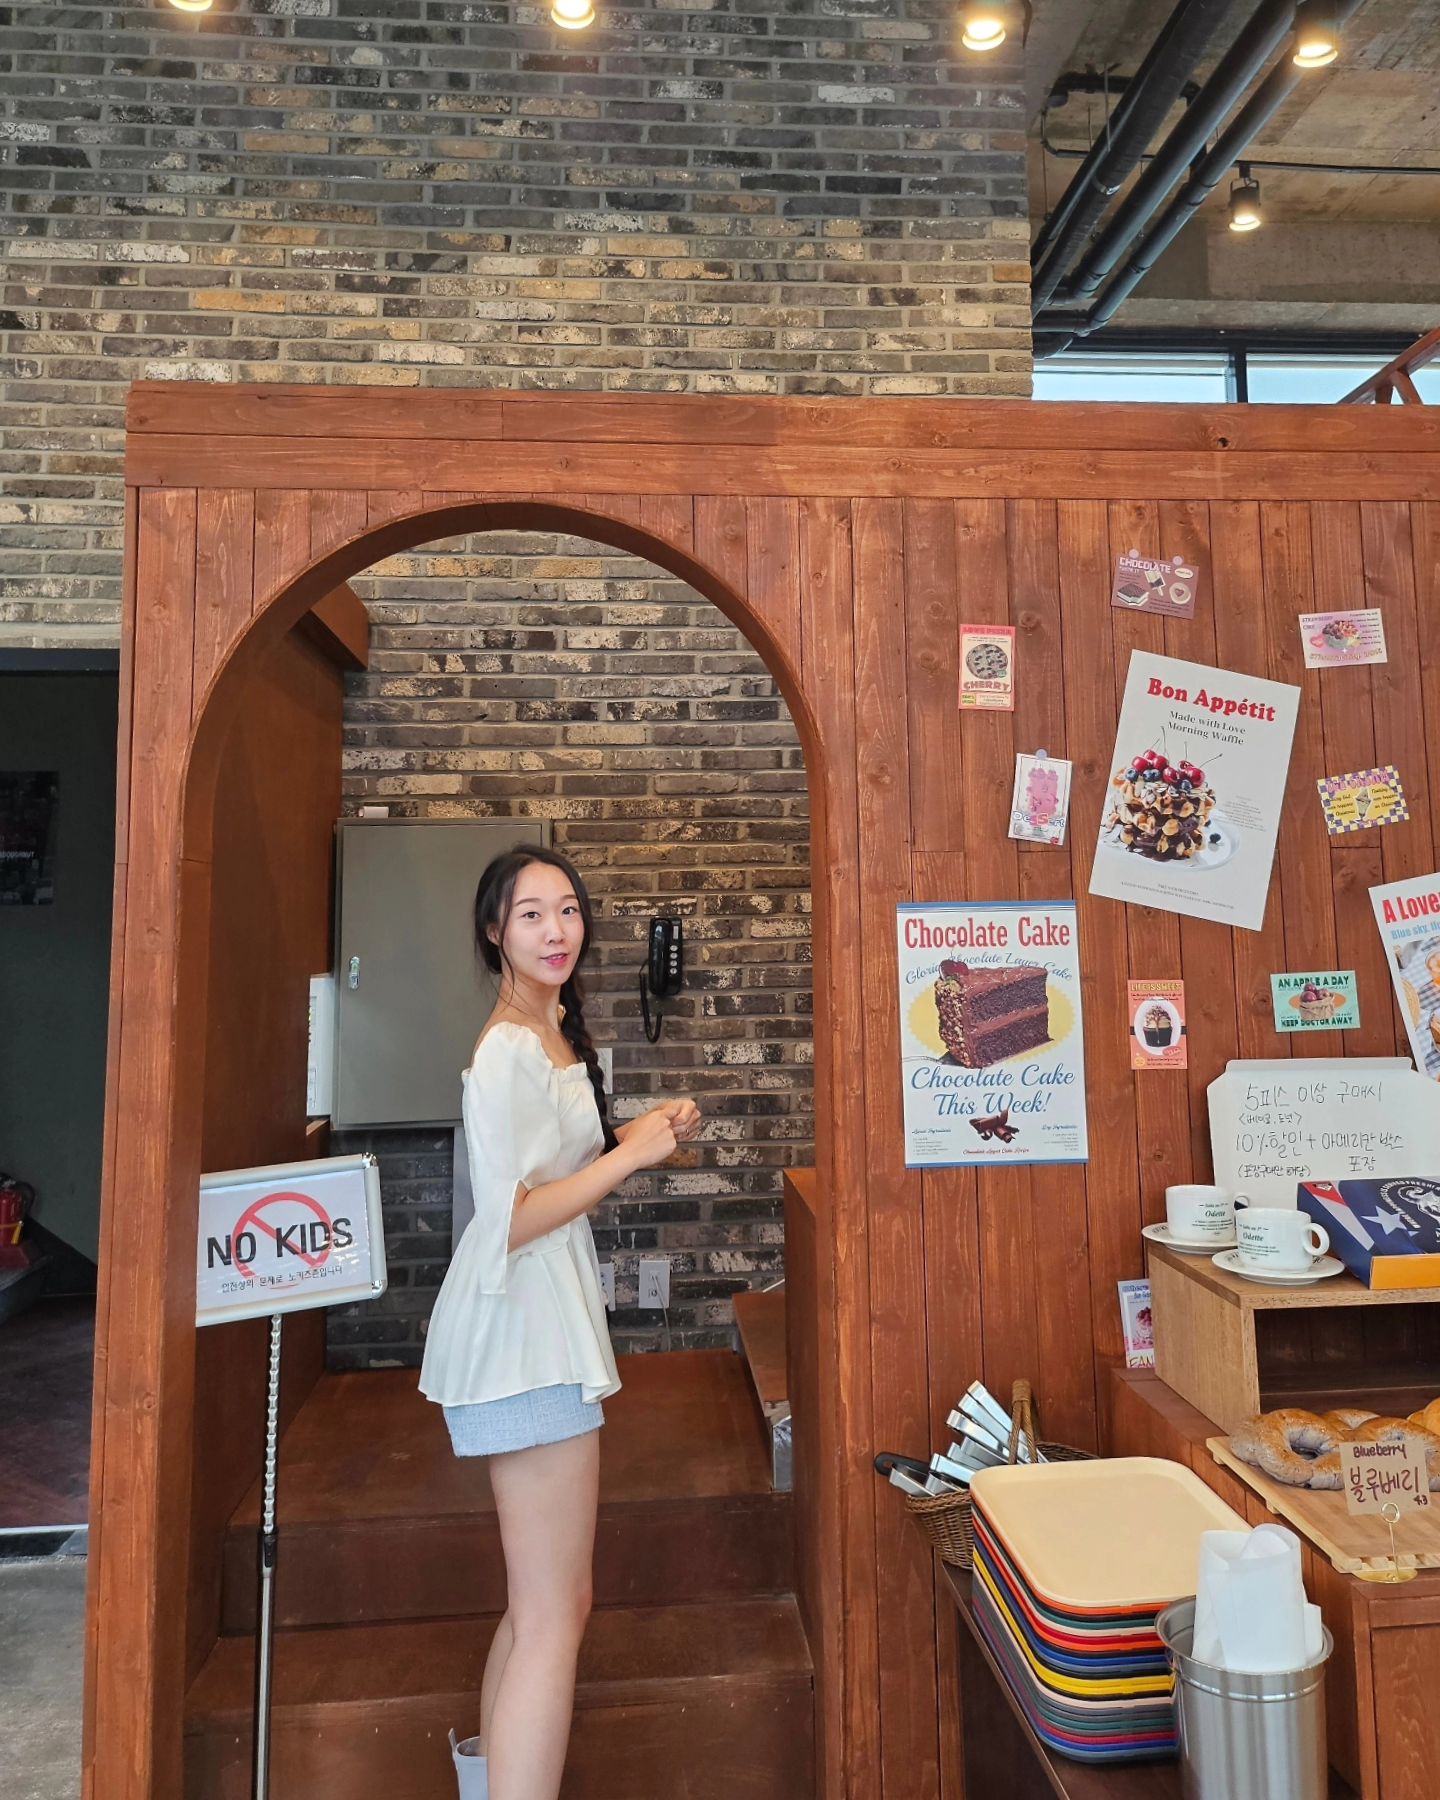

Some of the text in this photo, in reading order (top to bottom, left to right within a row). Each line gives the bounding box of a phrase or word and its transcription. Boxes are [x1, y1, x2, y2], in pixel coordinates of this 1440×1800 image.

[1119, 557, 1172, 574] CHOCOLATE
[963, 680, 1010, 691] CHERRY
[1147, 678, 1276, 721] Bon Appétit
[1170, 711, 1246, 734] Made with Love
[1167, 721, 1244, 745] Morning Waffle
[1382, 892, 1440, 923] A Love
[904, 916, 1070, 949] Chocolate Cake
[1391, 928, 1411, 940] Blue
[1278, 979, 1291, 988] AN
[1323, 977, 1329, 986] A
[1331, 975, 1349, 985] DAY
[1281, 1017, 1353, 1027] KEEP DOCTOR AWAY
[911, 1063, 1075, 1089] Chocolate Cake
[1298, 1082, 1328, 1103] 이상
[1336, 1081, 1382, 1103] 구매시
[934, 1091, 1052, 1115] This Week!
[1348, 1156, 1377, 1172] 포장
[1205, 1209, 1226, 1218] Odette
[207, 1217, 354, 1268] NO KIDS
[1242, 1232, 1264, 1242] Odette
[258, 1274, 283, 1287] 문제로
[1353, 1443, 1407, 1459] Blueberry
[1350, 1466, 1418, 1502] 블루베리
